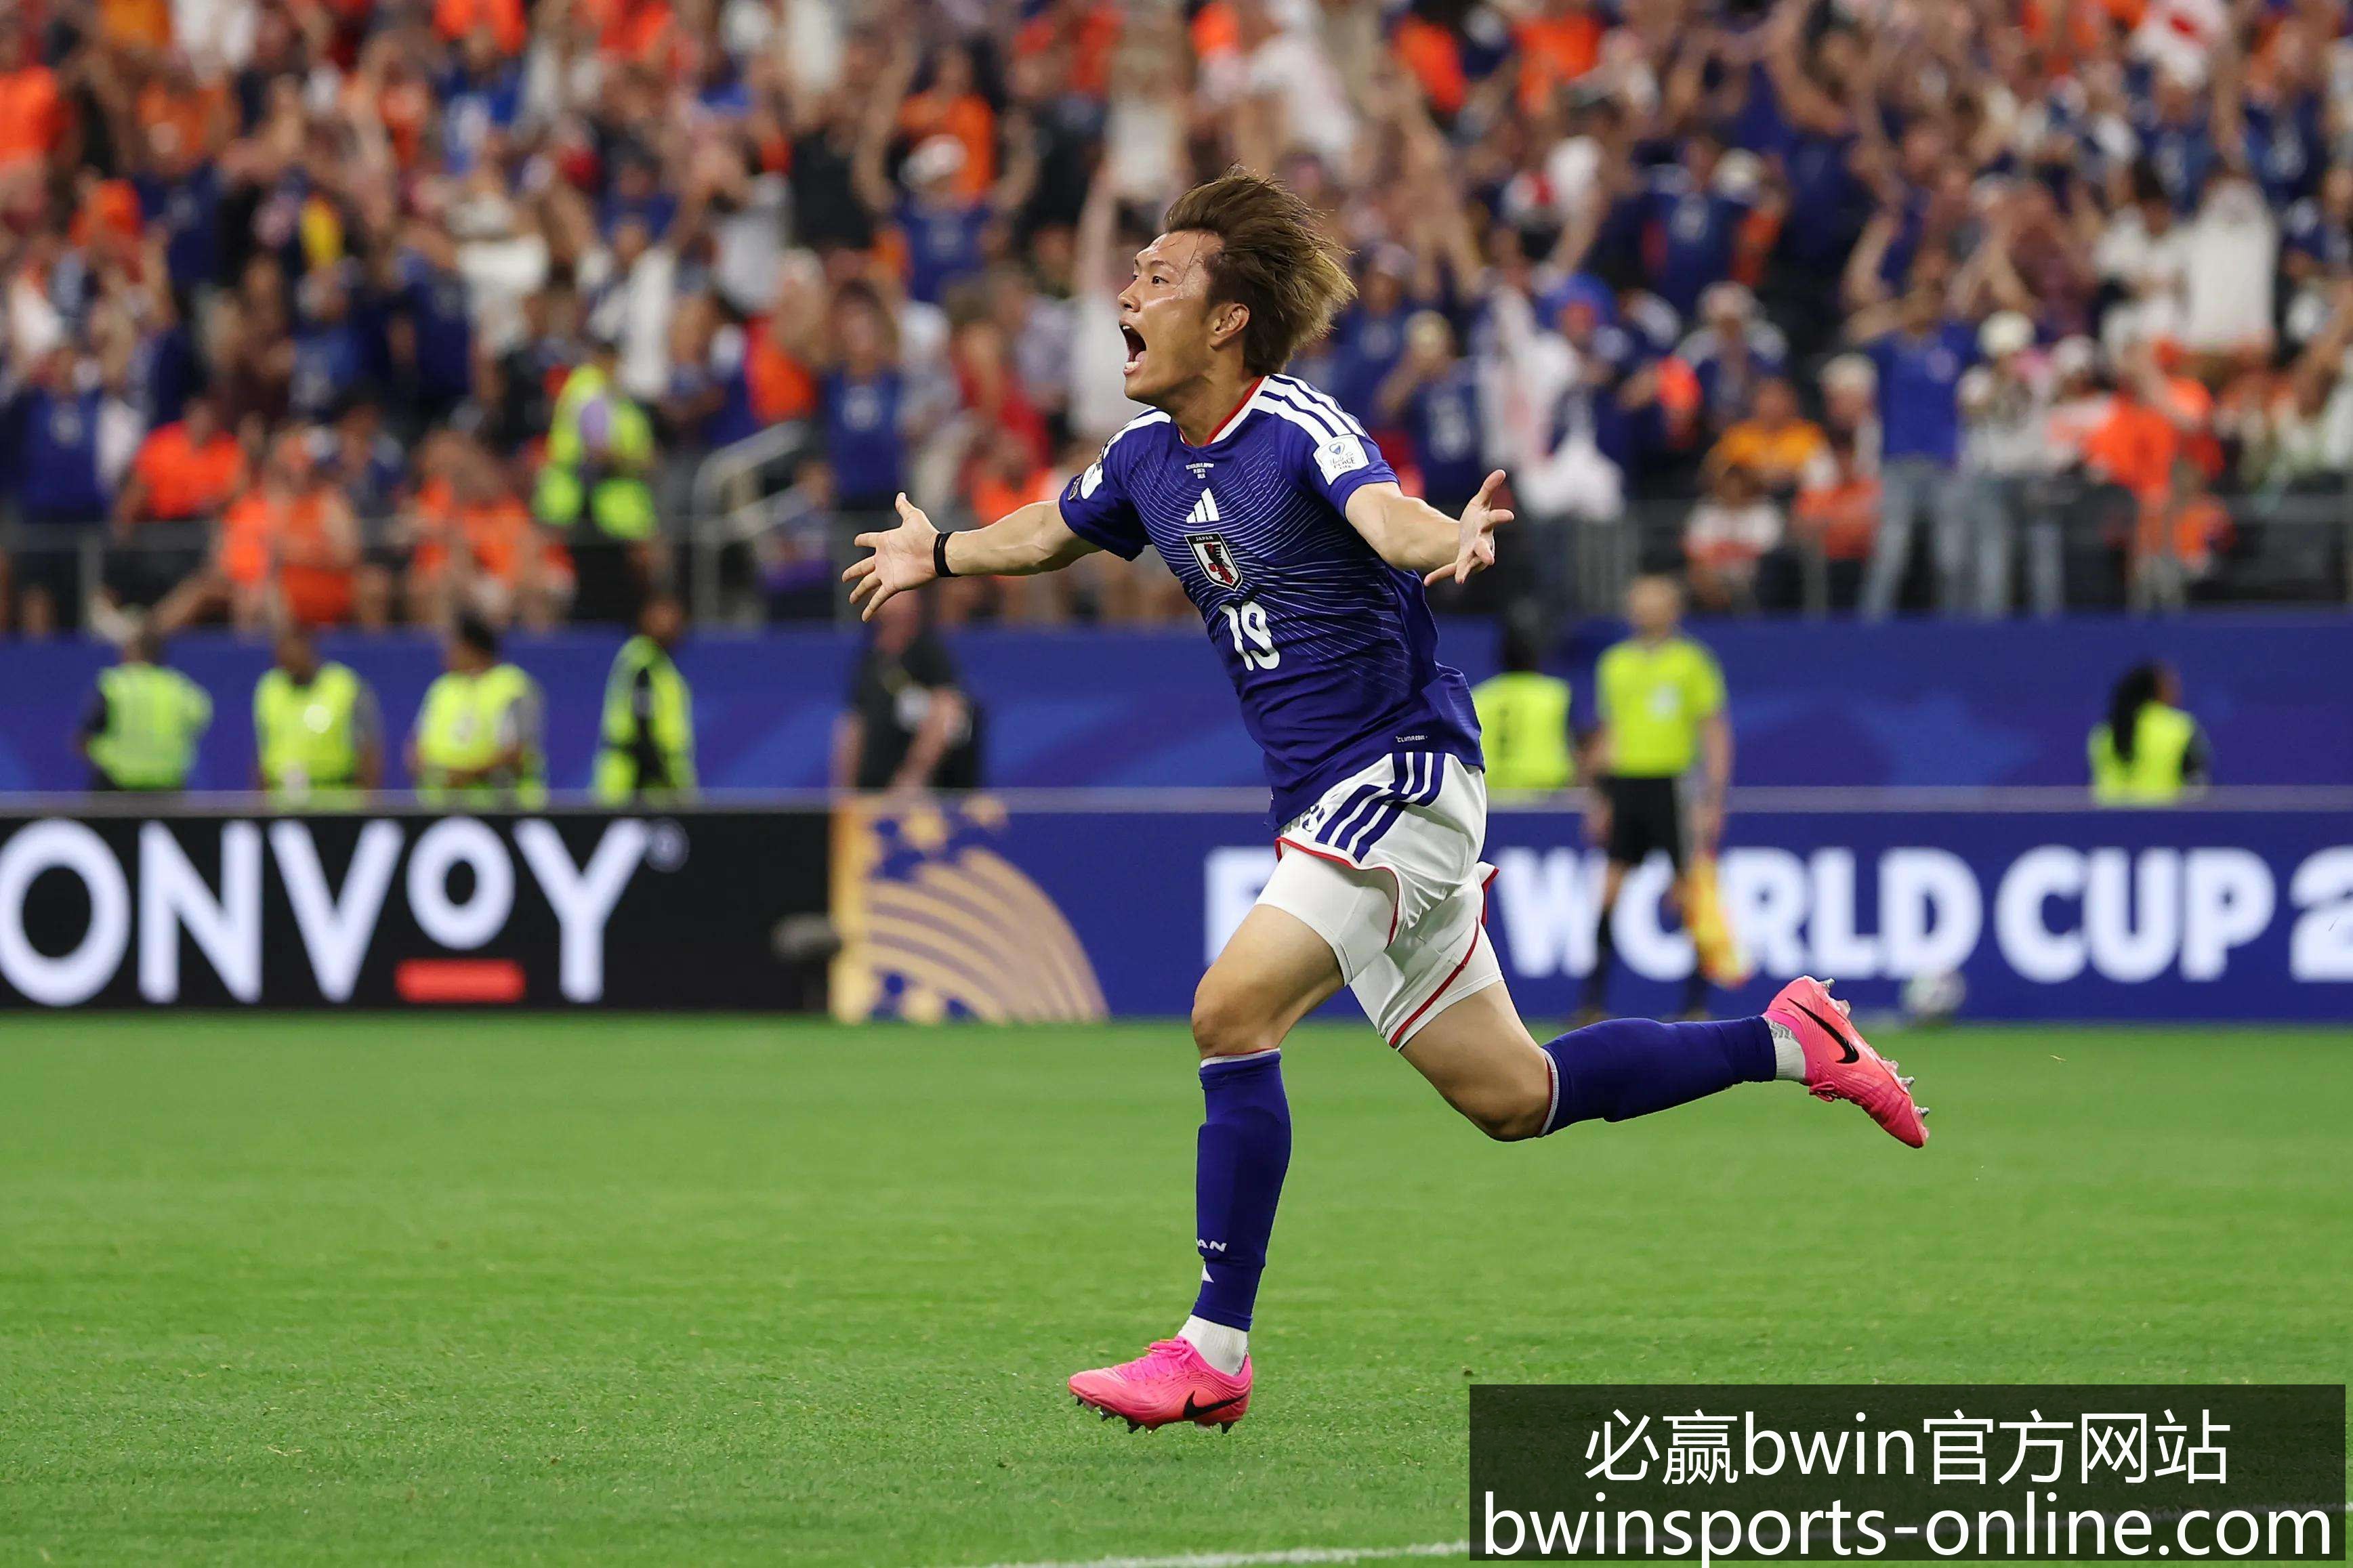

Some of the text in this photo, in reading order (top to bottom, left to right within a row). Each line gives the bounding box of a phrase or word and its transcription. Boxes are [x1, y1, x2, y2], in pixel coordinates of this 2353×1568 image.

[1219, 601, 1280, 671] 19
[1494, 847, 1983, 981] WORLD
[1994, 845, 2276, 983] CUP
